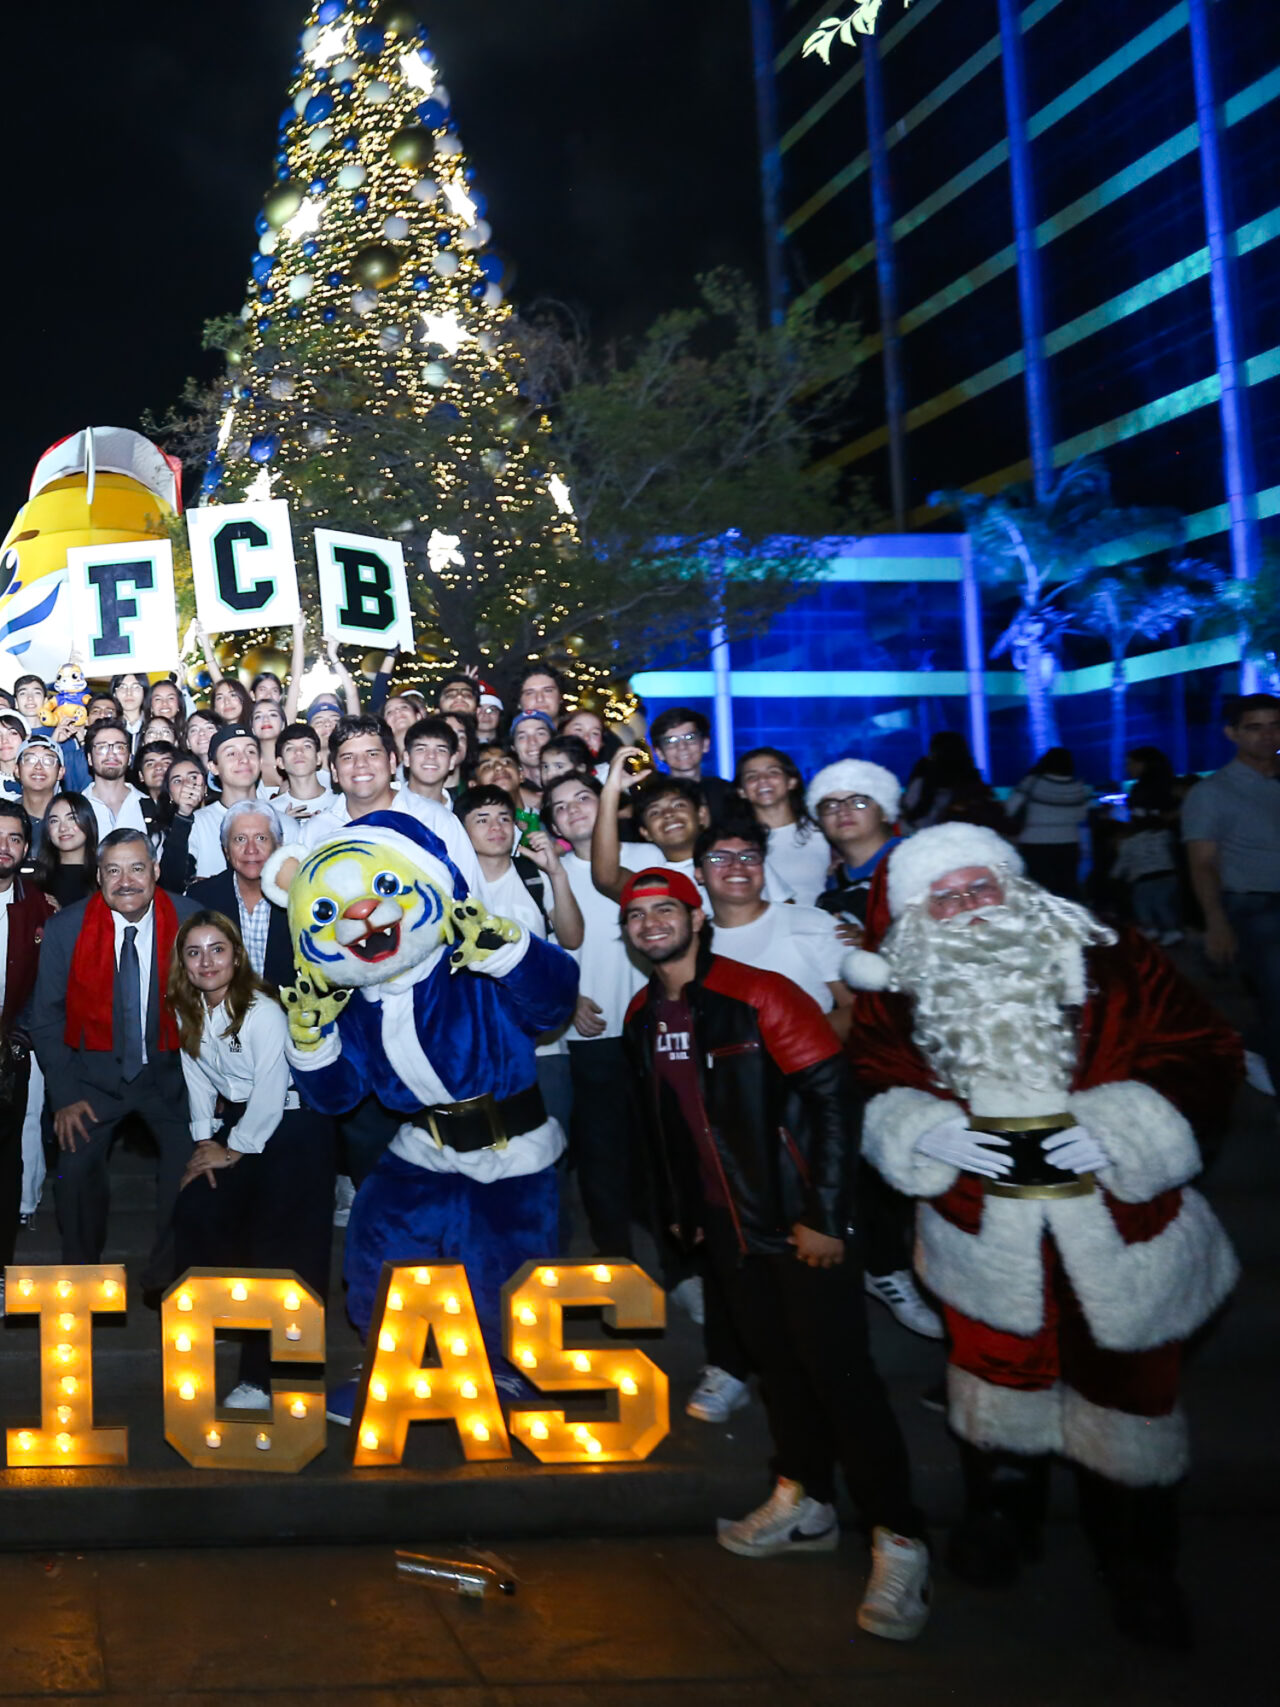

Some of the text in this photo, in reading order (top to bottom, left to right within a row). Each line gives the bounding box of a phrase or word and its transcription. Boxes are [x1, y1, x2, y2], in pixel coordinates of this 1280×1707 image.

[84, 556, 156, 659] F
[210, 517, 277, 613] C
[330, 543, 401, 633] B
